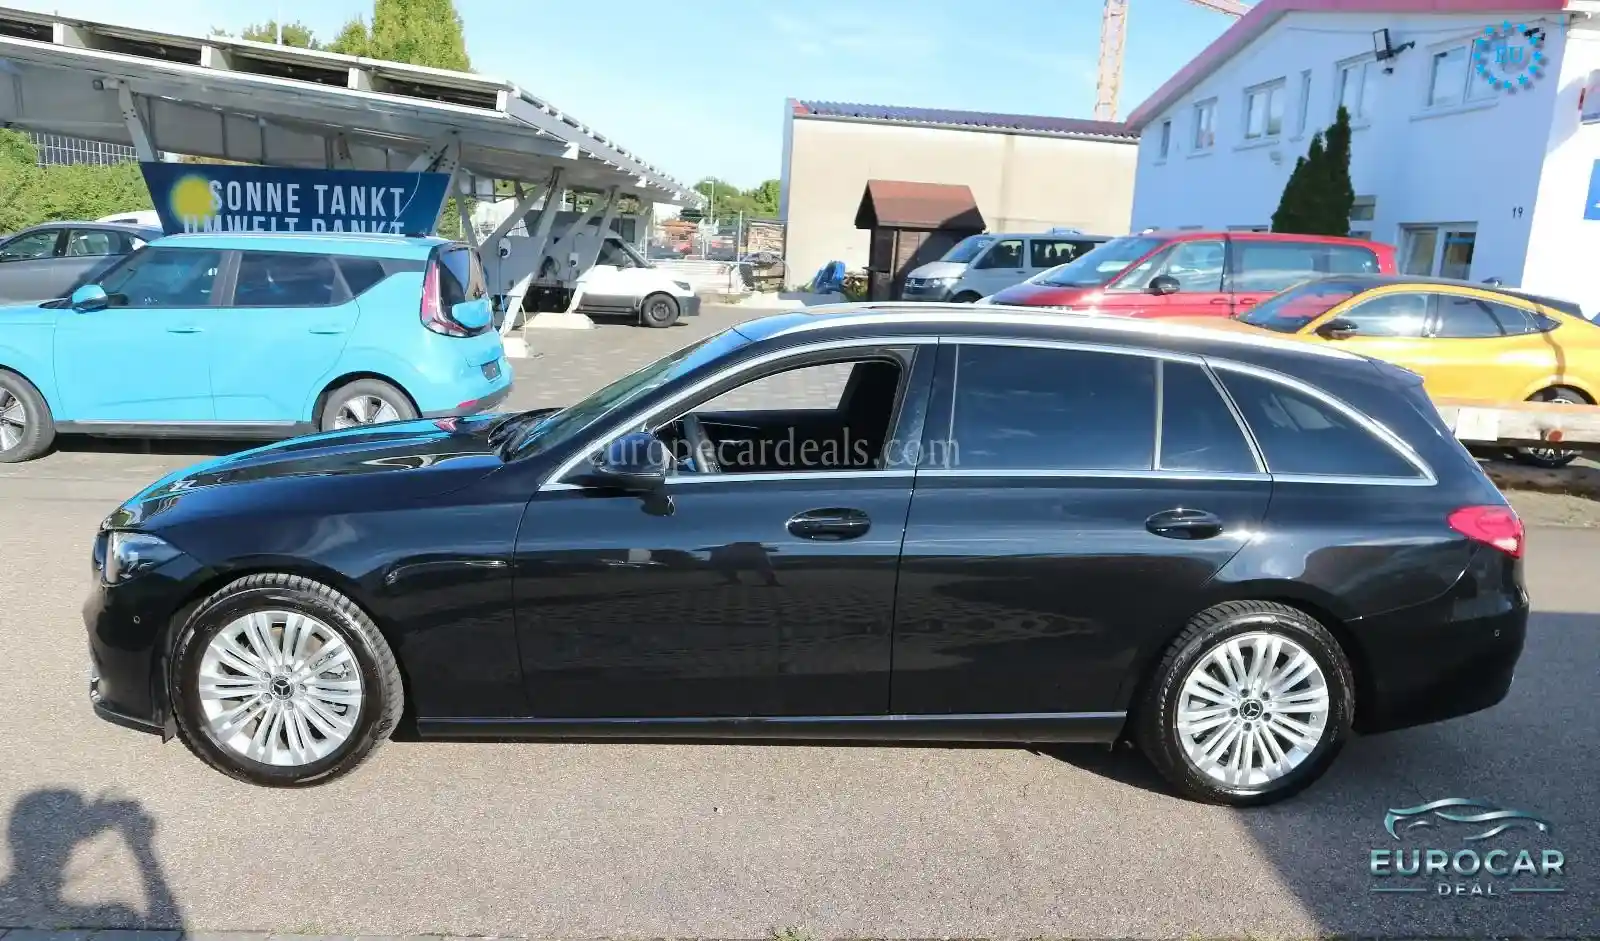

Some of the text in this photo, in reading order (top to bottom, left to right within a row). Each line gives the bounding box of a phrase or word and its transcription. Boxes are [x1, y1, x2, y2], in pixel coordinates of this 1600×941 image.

[208, 180, 405, 218] SONNE TANKT
[1512, 206, 1523, 218] 19
